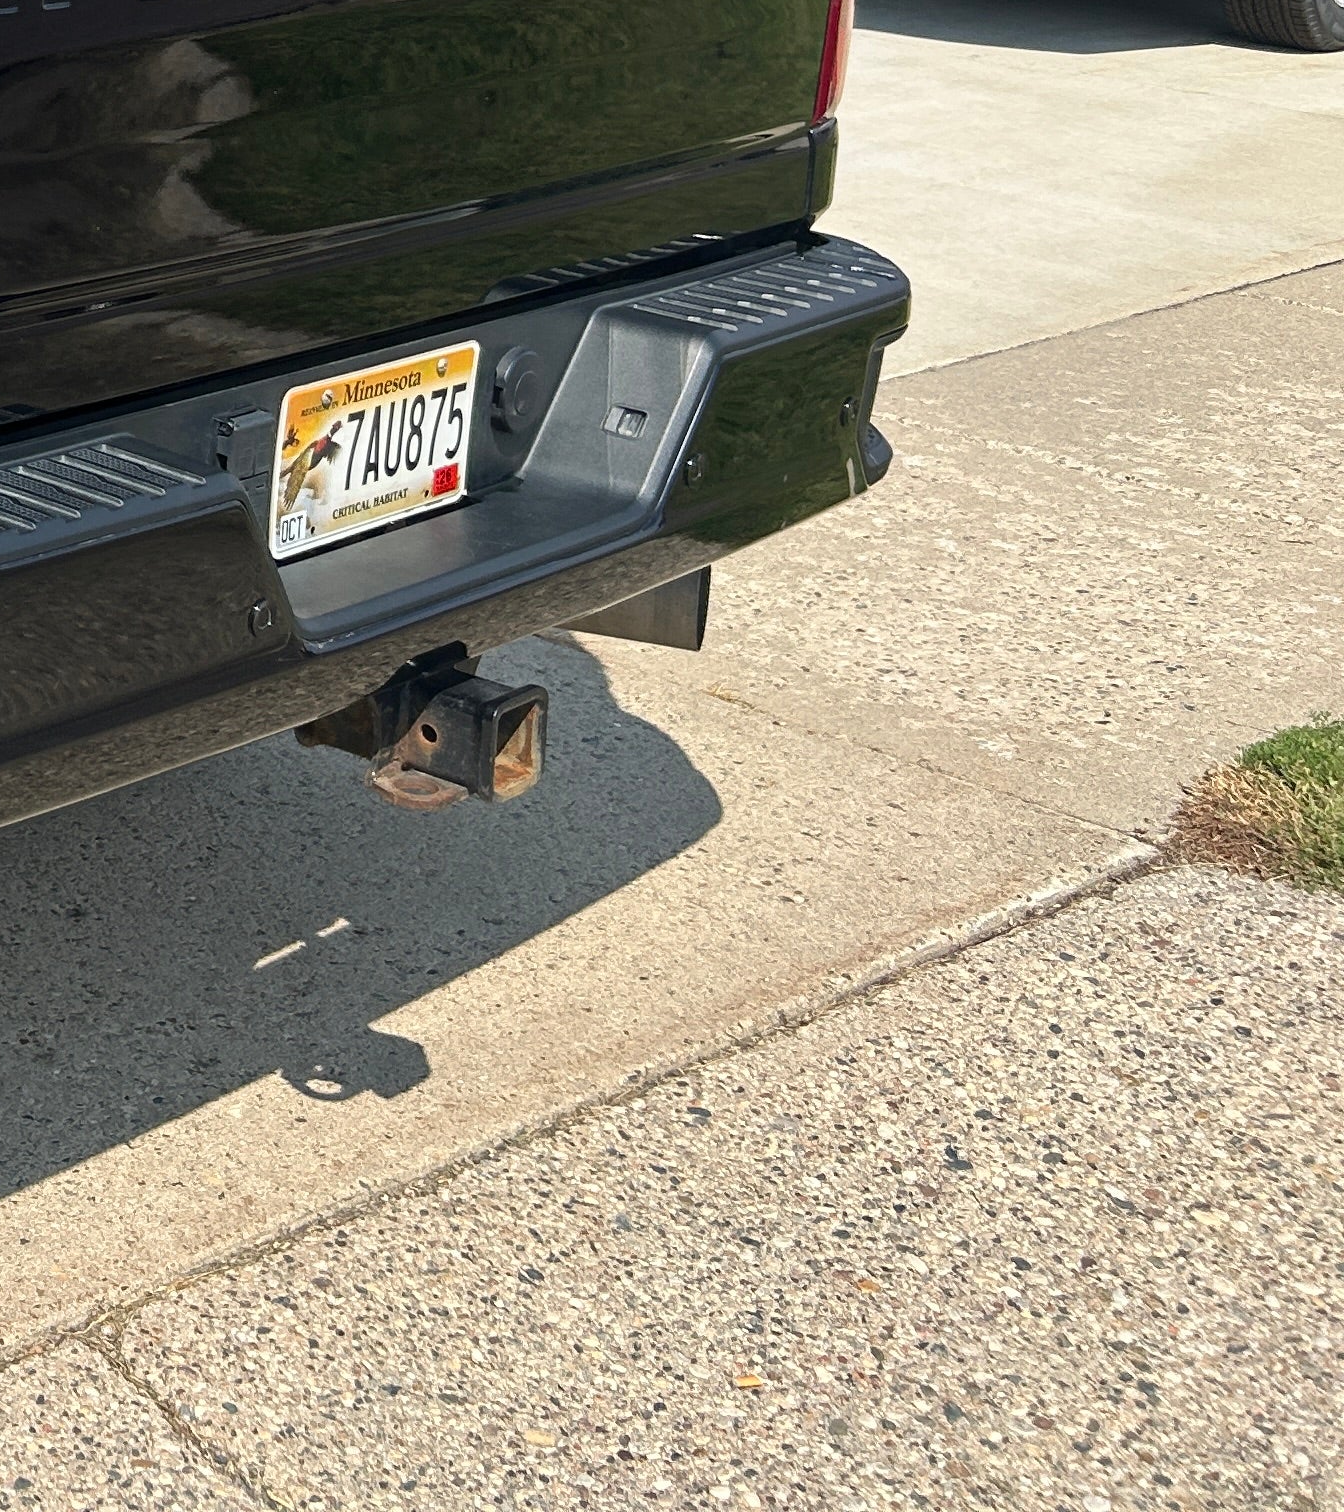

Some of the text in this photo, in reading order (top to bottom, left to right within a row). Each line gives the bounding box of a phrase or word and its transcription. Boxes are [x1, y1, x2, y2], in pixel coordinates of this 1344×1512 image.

[342, 370, 421, 406] Minnesota
[345, 382, 467, 490] 7AU875
[332, 488, 409, 520] CRITICAL HABITAT
[281, 515, 304, 544] OCT
